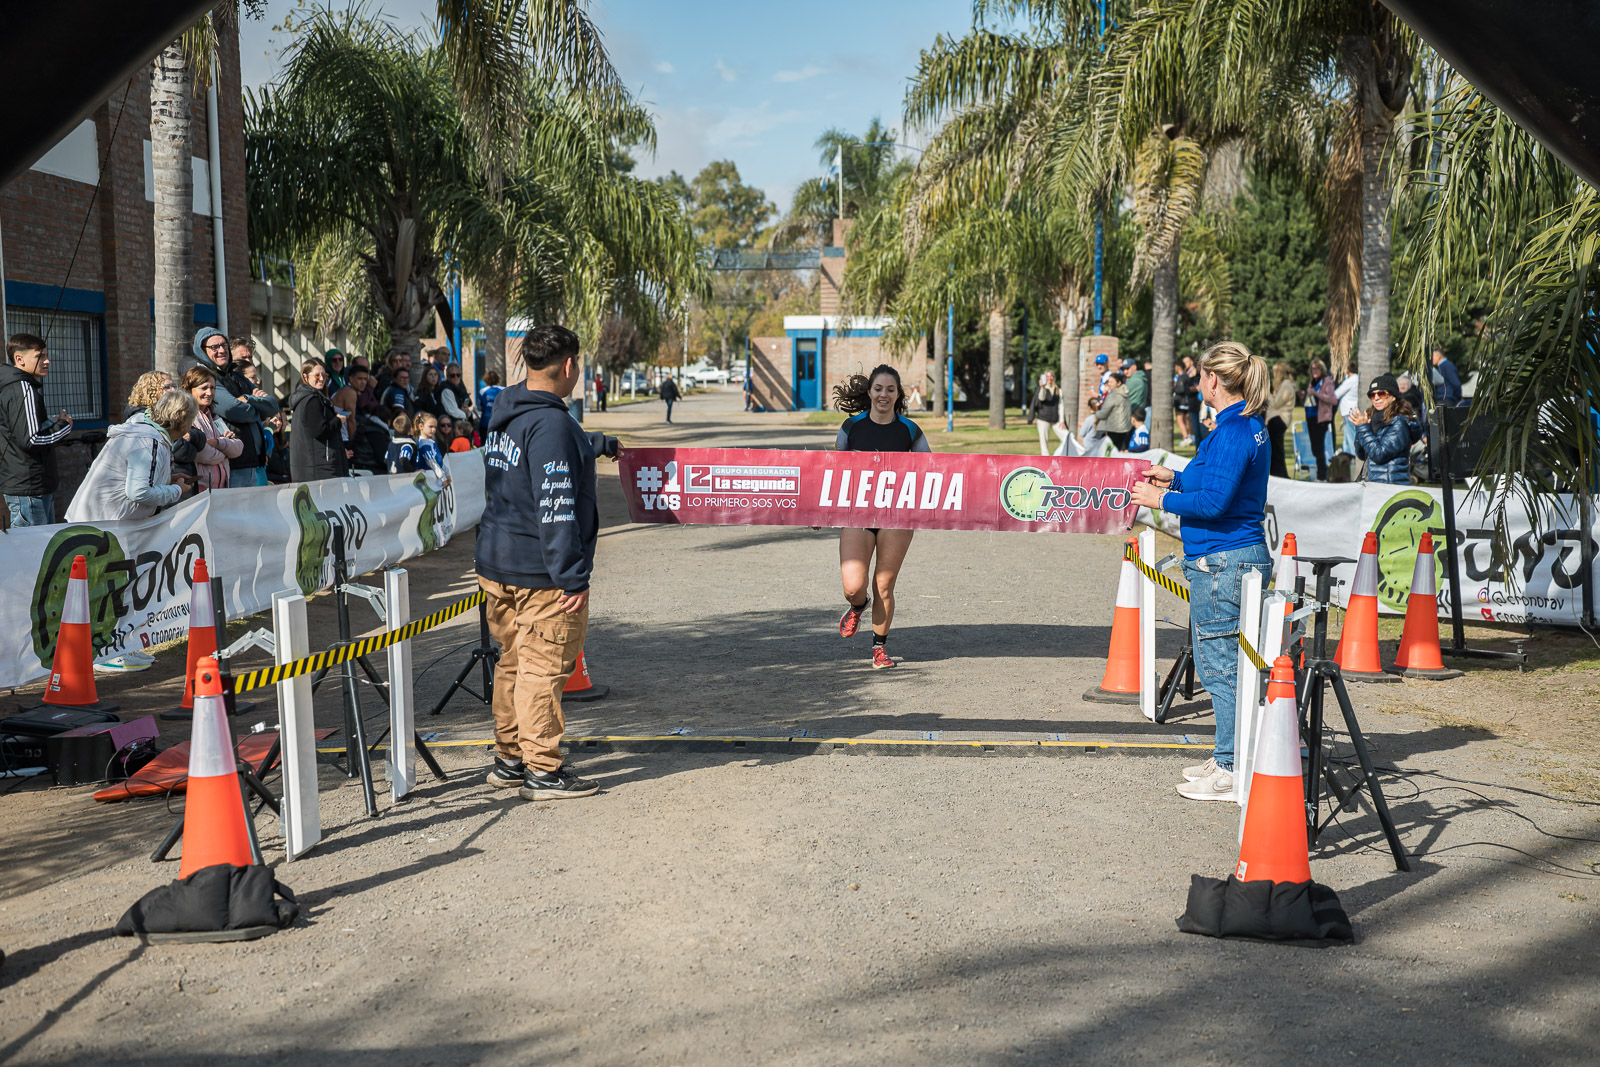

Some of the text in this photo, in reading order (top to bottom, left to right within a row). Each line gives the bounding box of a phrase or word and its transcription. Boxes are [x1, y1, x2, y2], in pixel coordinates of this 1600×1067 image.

[637, 461, 681, 492] #1
[715, 477, 796, 492] La segunda
[819, 469, 963, 511] LLEGADA
[641, 494, 681, 511] VOS
[687, 497, 797, 509] LO PRIMERO SOS VOS
[1035, 510, 1075, 523] RAV
[1491, 590, 1565, 611] @cronorav
